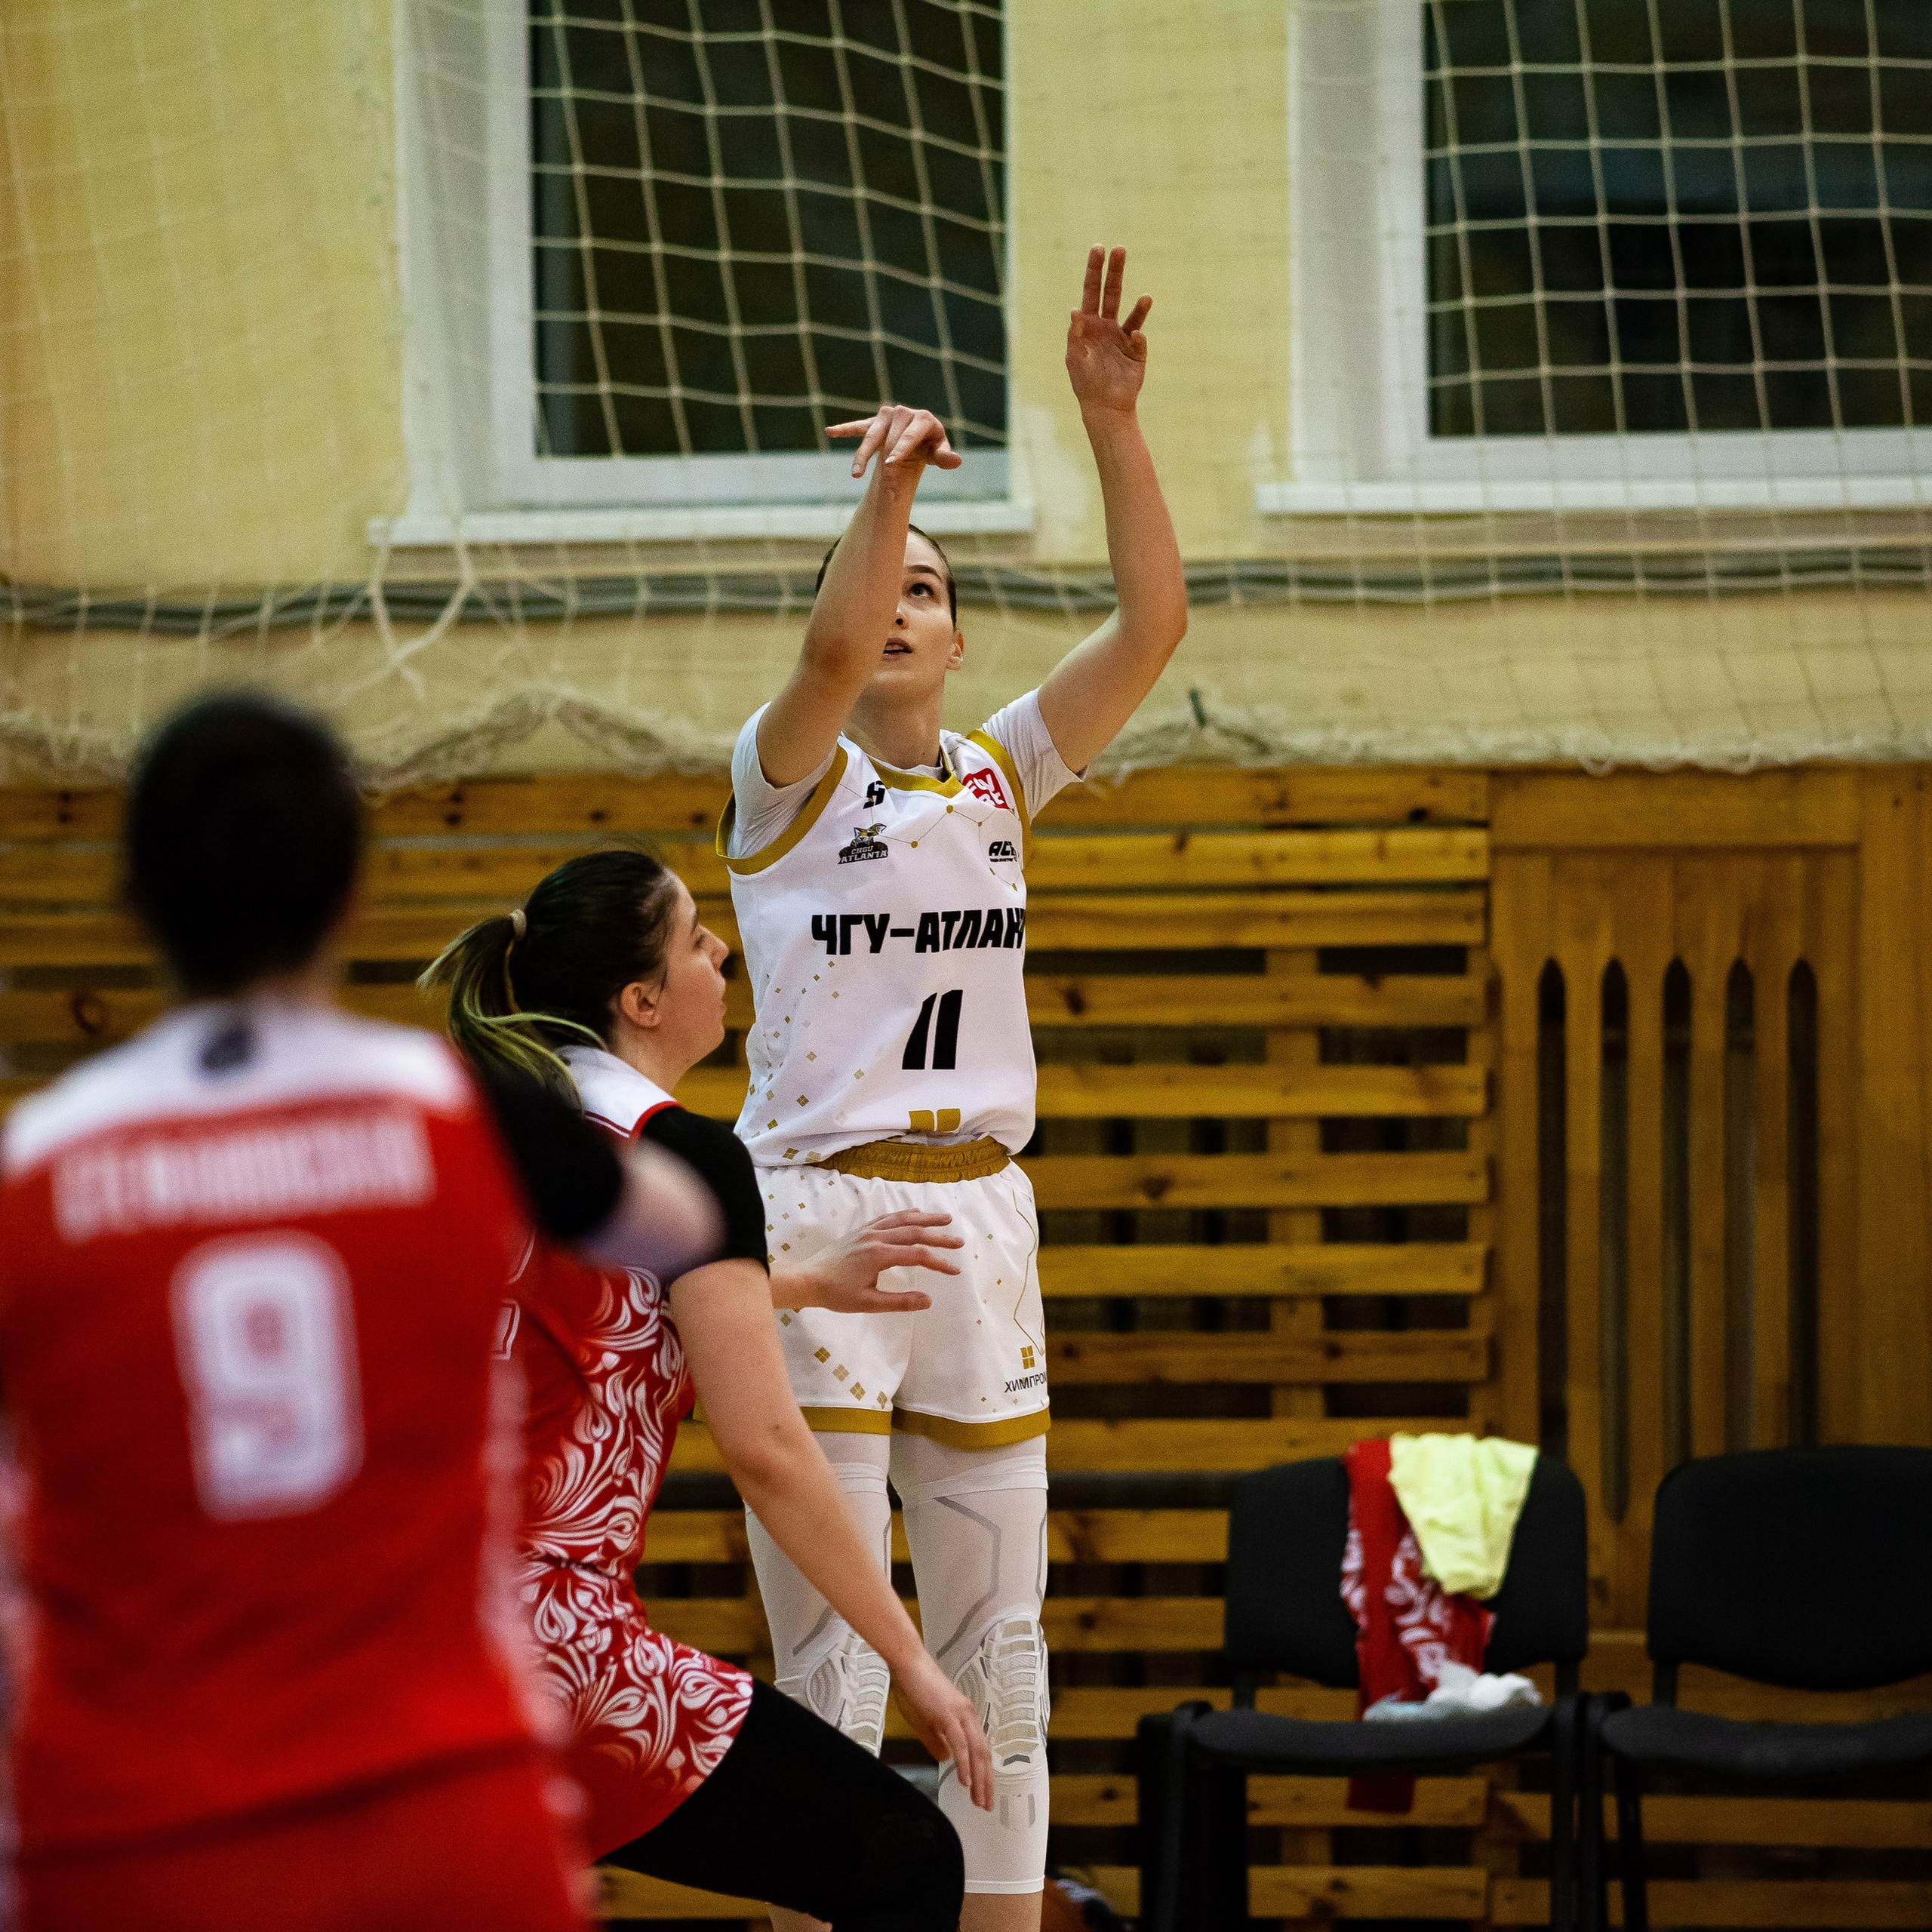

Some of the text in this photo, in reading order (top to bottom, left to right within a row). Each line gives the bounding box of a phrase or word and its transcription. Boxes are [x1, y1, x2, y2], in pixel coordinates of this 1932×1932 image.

[841, 850, 888, 863] ATLANTA
[901, 989, 964, 1070] 11
[171, 1230, 367, 1523] 9
